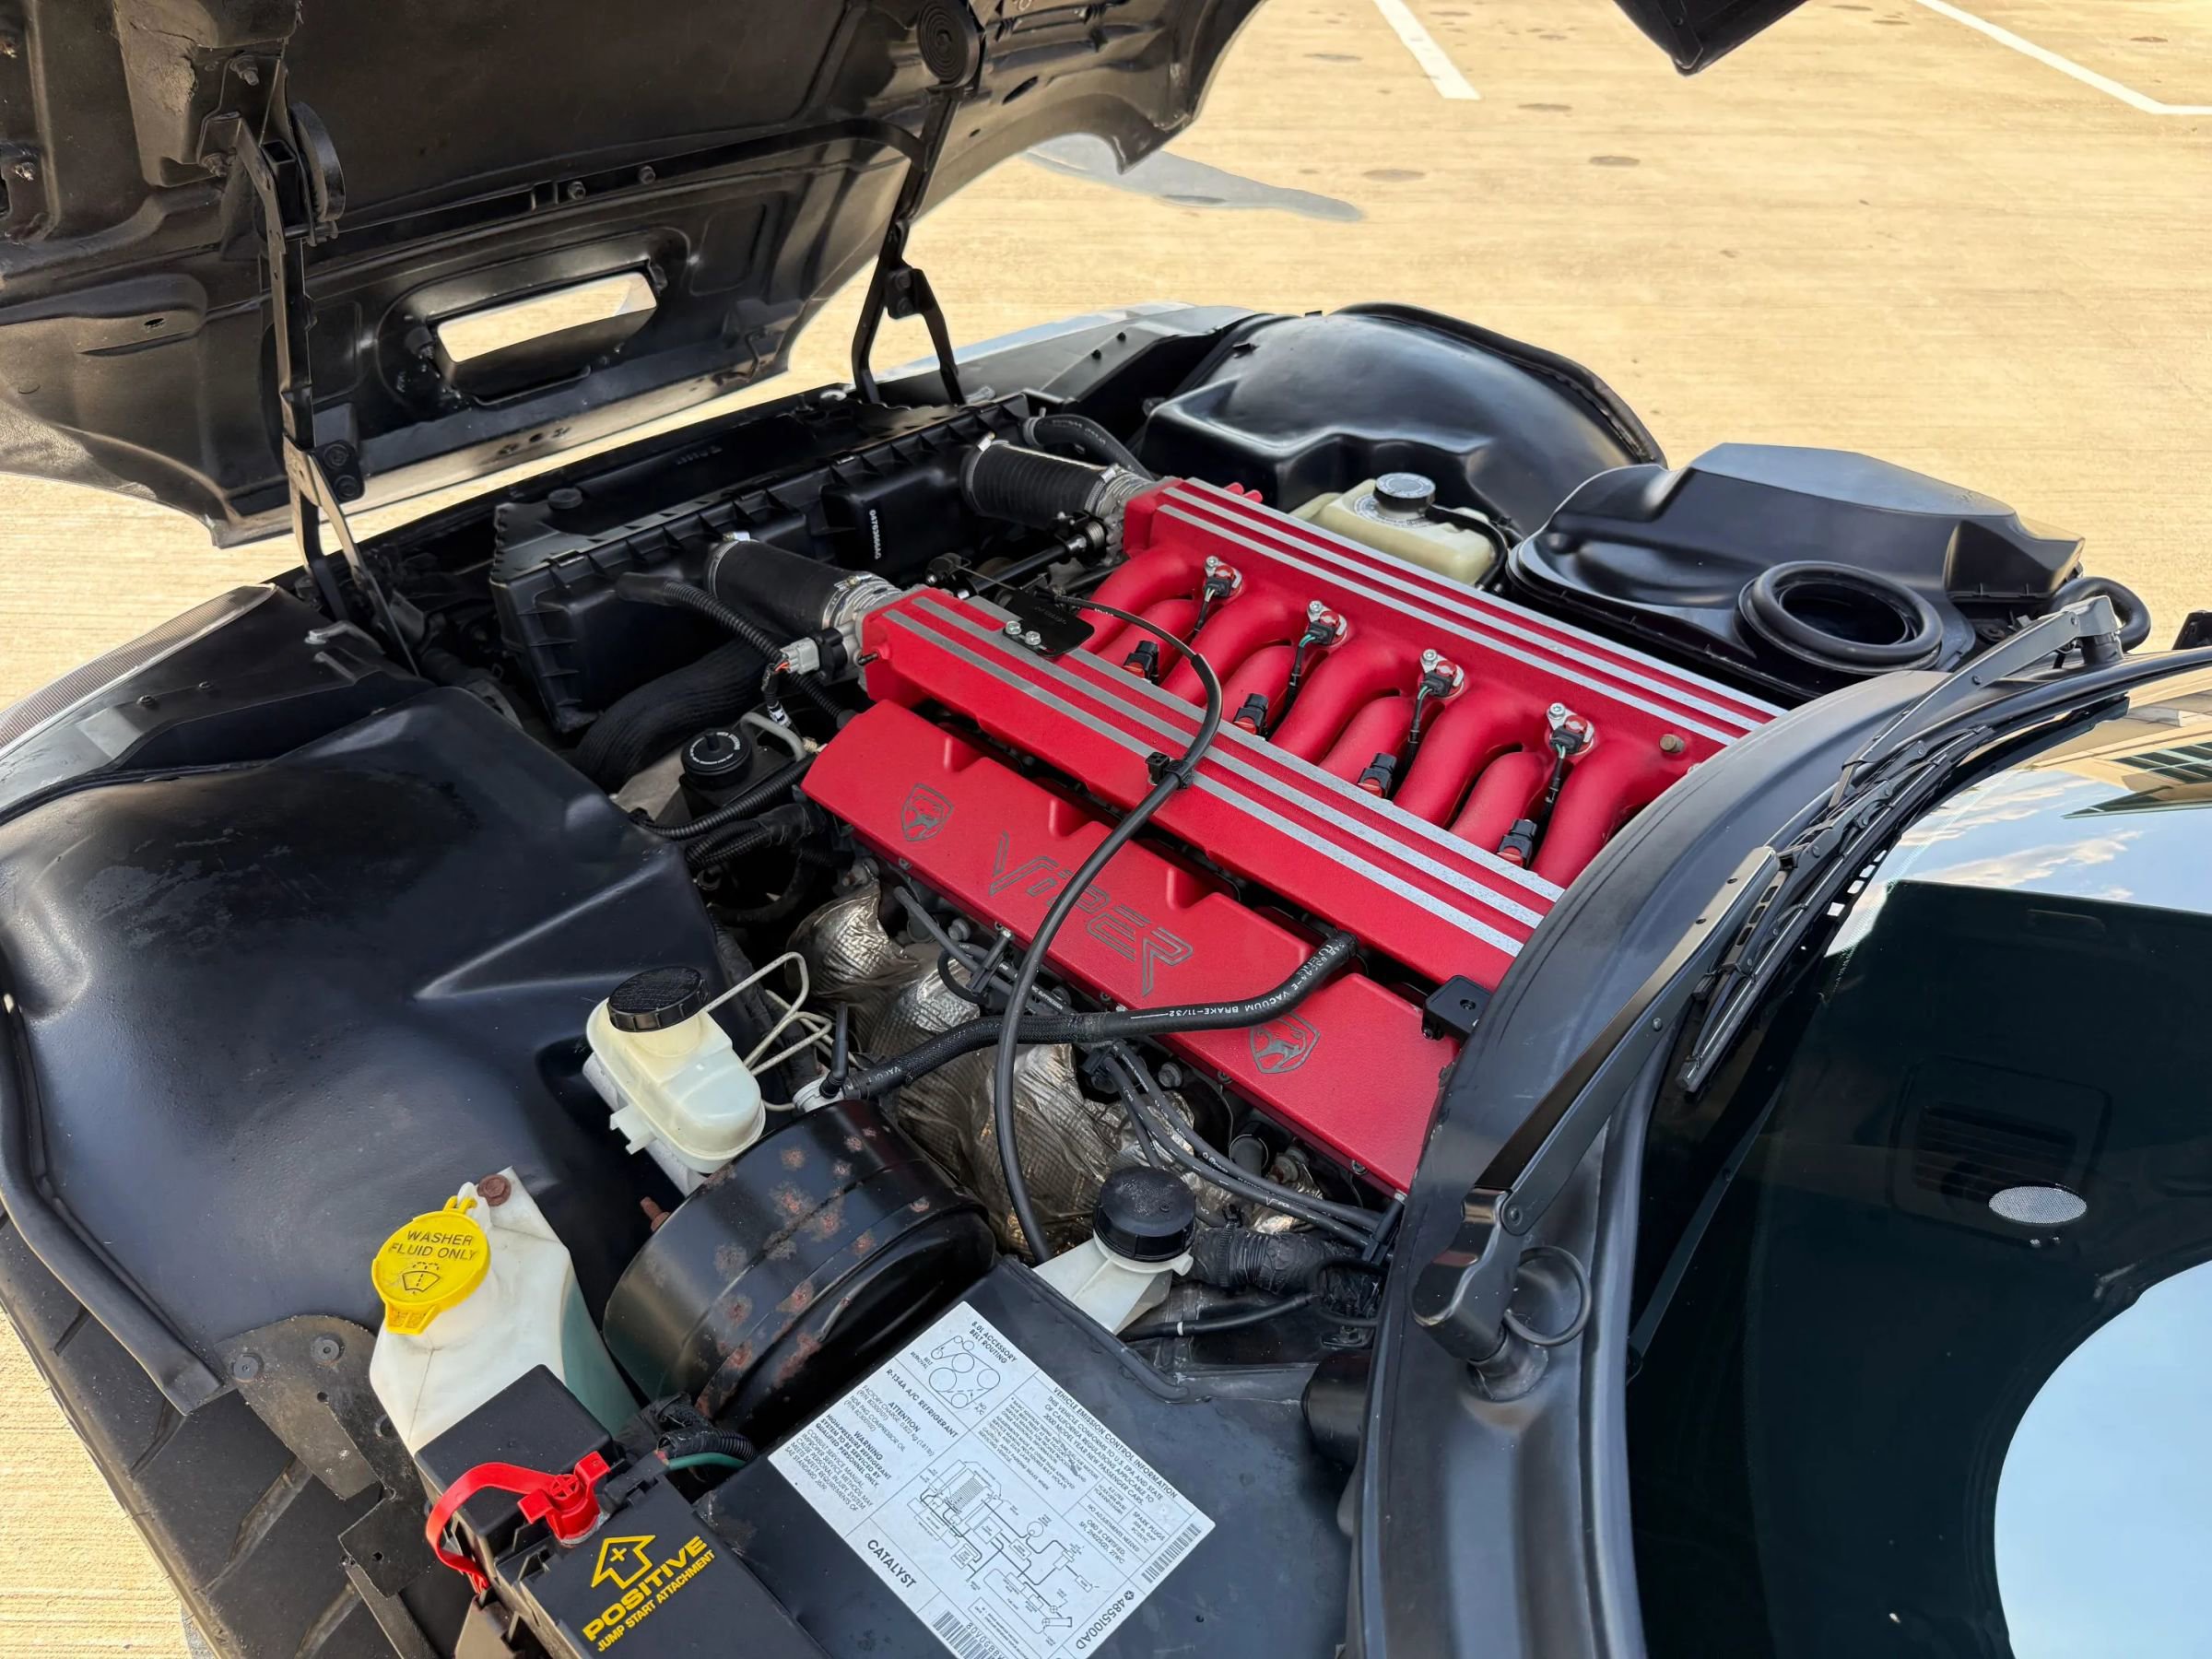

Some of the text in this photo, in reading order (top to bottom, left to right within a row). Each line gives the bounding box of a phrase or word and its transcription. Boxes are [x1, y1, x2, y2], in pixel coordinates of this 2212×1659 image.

[1243, 990, 1290, 1012] VACUUM
[389, 1242, 478, 1261] FLUID ONLY
[406, 1230, 474, 1246] WASHER
[968, 1328, 1008, 1364] BELT ROUTING
[982, 1331, 1018, 1362] ACCESSORY
[884, 1369, 959, 1438] R-134A A/C REFRIGERANT
[887, 1400, 922, 1432] ATTENTION
[977, 1401, 987, 1410] NO
[799, 1432, 875, 1507] IMPROPER SERVICE METHODS MAY
[805, 1429, 829, 1451] CONSULT
[825, 1448, 846, 1468] SERVICE
[813, 1422, 880, 1488] QUALIFIED PERSONNEL ONLY.
[818, 1418, 882, 1479] SYSTEM TO BE SERVICED BY
[824, 1414, 892, 1480] HIGH-PRESSURE REFRIGERANT
[852, 1430, 884, 1461] WARNING
[1042, 1412, 1057, 1426] 2000
[1053, 1423, 1075, 1441] MODEL
[1071, 1439, 1088, 1453] YEAR
[1085, 1452, 1100, 1465] NEW
[1097, 1462, 1129, 1491] PASSENGER
[1126, 1488, 1146, 1506] CARS.
[1043, 1403, 1053, 1412] OF
[1051, 1409, 1084, 1439] CALIFORNIA
[1080, 1436, 1117, 1469] REGULATIONS
[1114, 1466, 1147, 1496] APPLICABLE
[1144, 1493, 1155, 1503] TO
[1046, 1395, 1059, 1407] THIS
[1056, 1405, 1079, 1425] VEHICLE
[1076, 1422, 1109, 1451] CONFORMS
[1105, 1448, 1116, 1458] TO
[1123, 1464, 1136, 1477] EPA
[1133, 1473, 1148, 1488] AND
[1146, 1484, 1164, 1500] STATE
[1052, 1386, 1178, 1499] VEHICLE EMISSION CONTROL INFORMATION
[788, 1441, 860, 1512] MEETS SAFETY REQUIREMENTS OF
[794, 1437, 812, 1454] CAUSE
[808, 1452, 834, 1477] PERSONAL
[846, 1489, 867, 1510] SYSTEM
[1132, 1511, 1165, 1541] SPARK PLUGS
[582, 1535, 708, 1641] POSITIVE
[865, 1537, 917, 1589] CATALYST
[597, 1549, 715, 1652] JUMP START ATTACHMENT
[1072, 1596, 1128, 1652] 4855100AD
